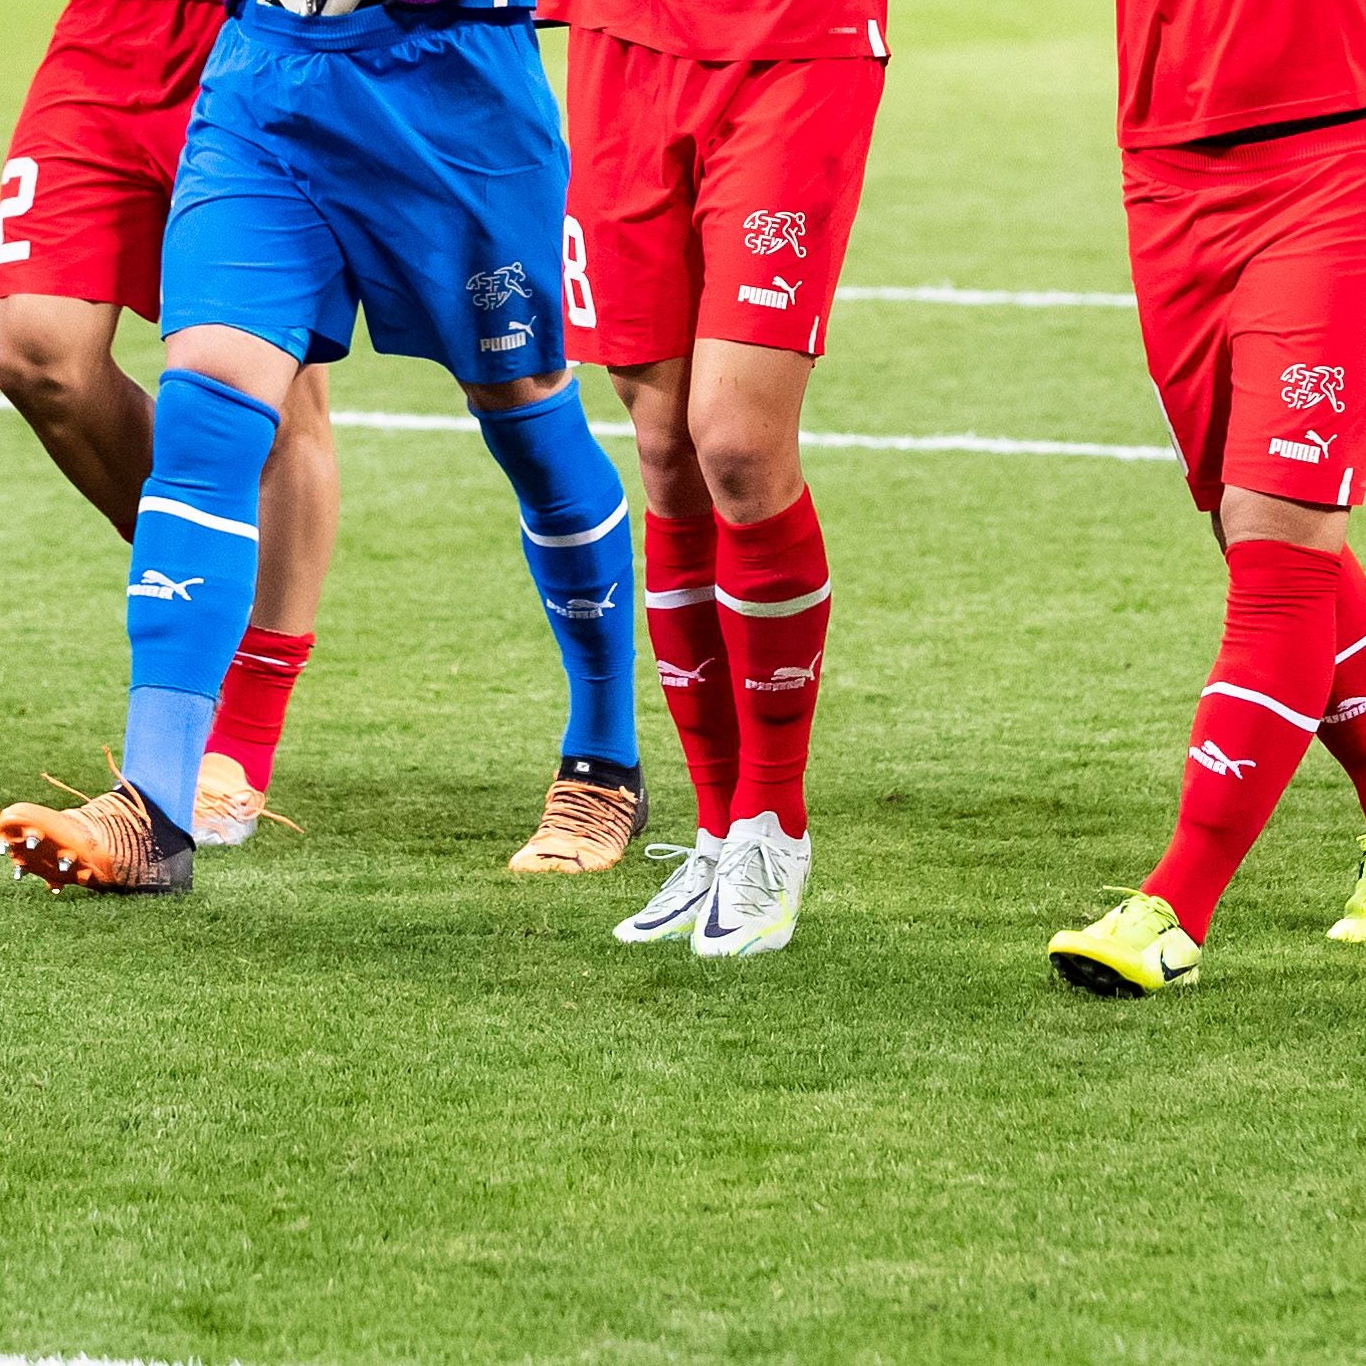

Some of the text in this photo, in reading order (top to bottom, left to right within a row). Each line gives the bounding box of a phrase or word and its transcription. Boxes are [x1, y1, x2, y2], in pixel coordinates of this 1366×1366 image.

[561, 213, 597, 330] 8
[737, 284, 789, 310] PUMA
[480, 331, 527, 352] PUMA
[1268, 437, 1322, 464] PUMA
[126, 583, 174, 601] UMA
